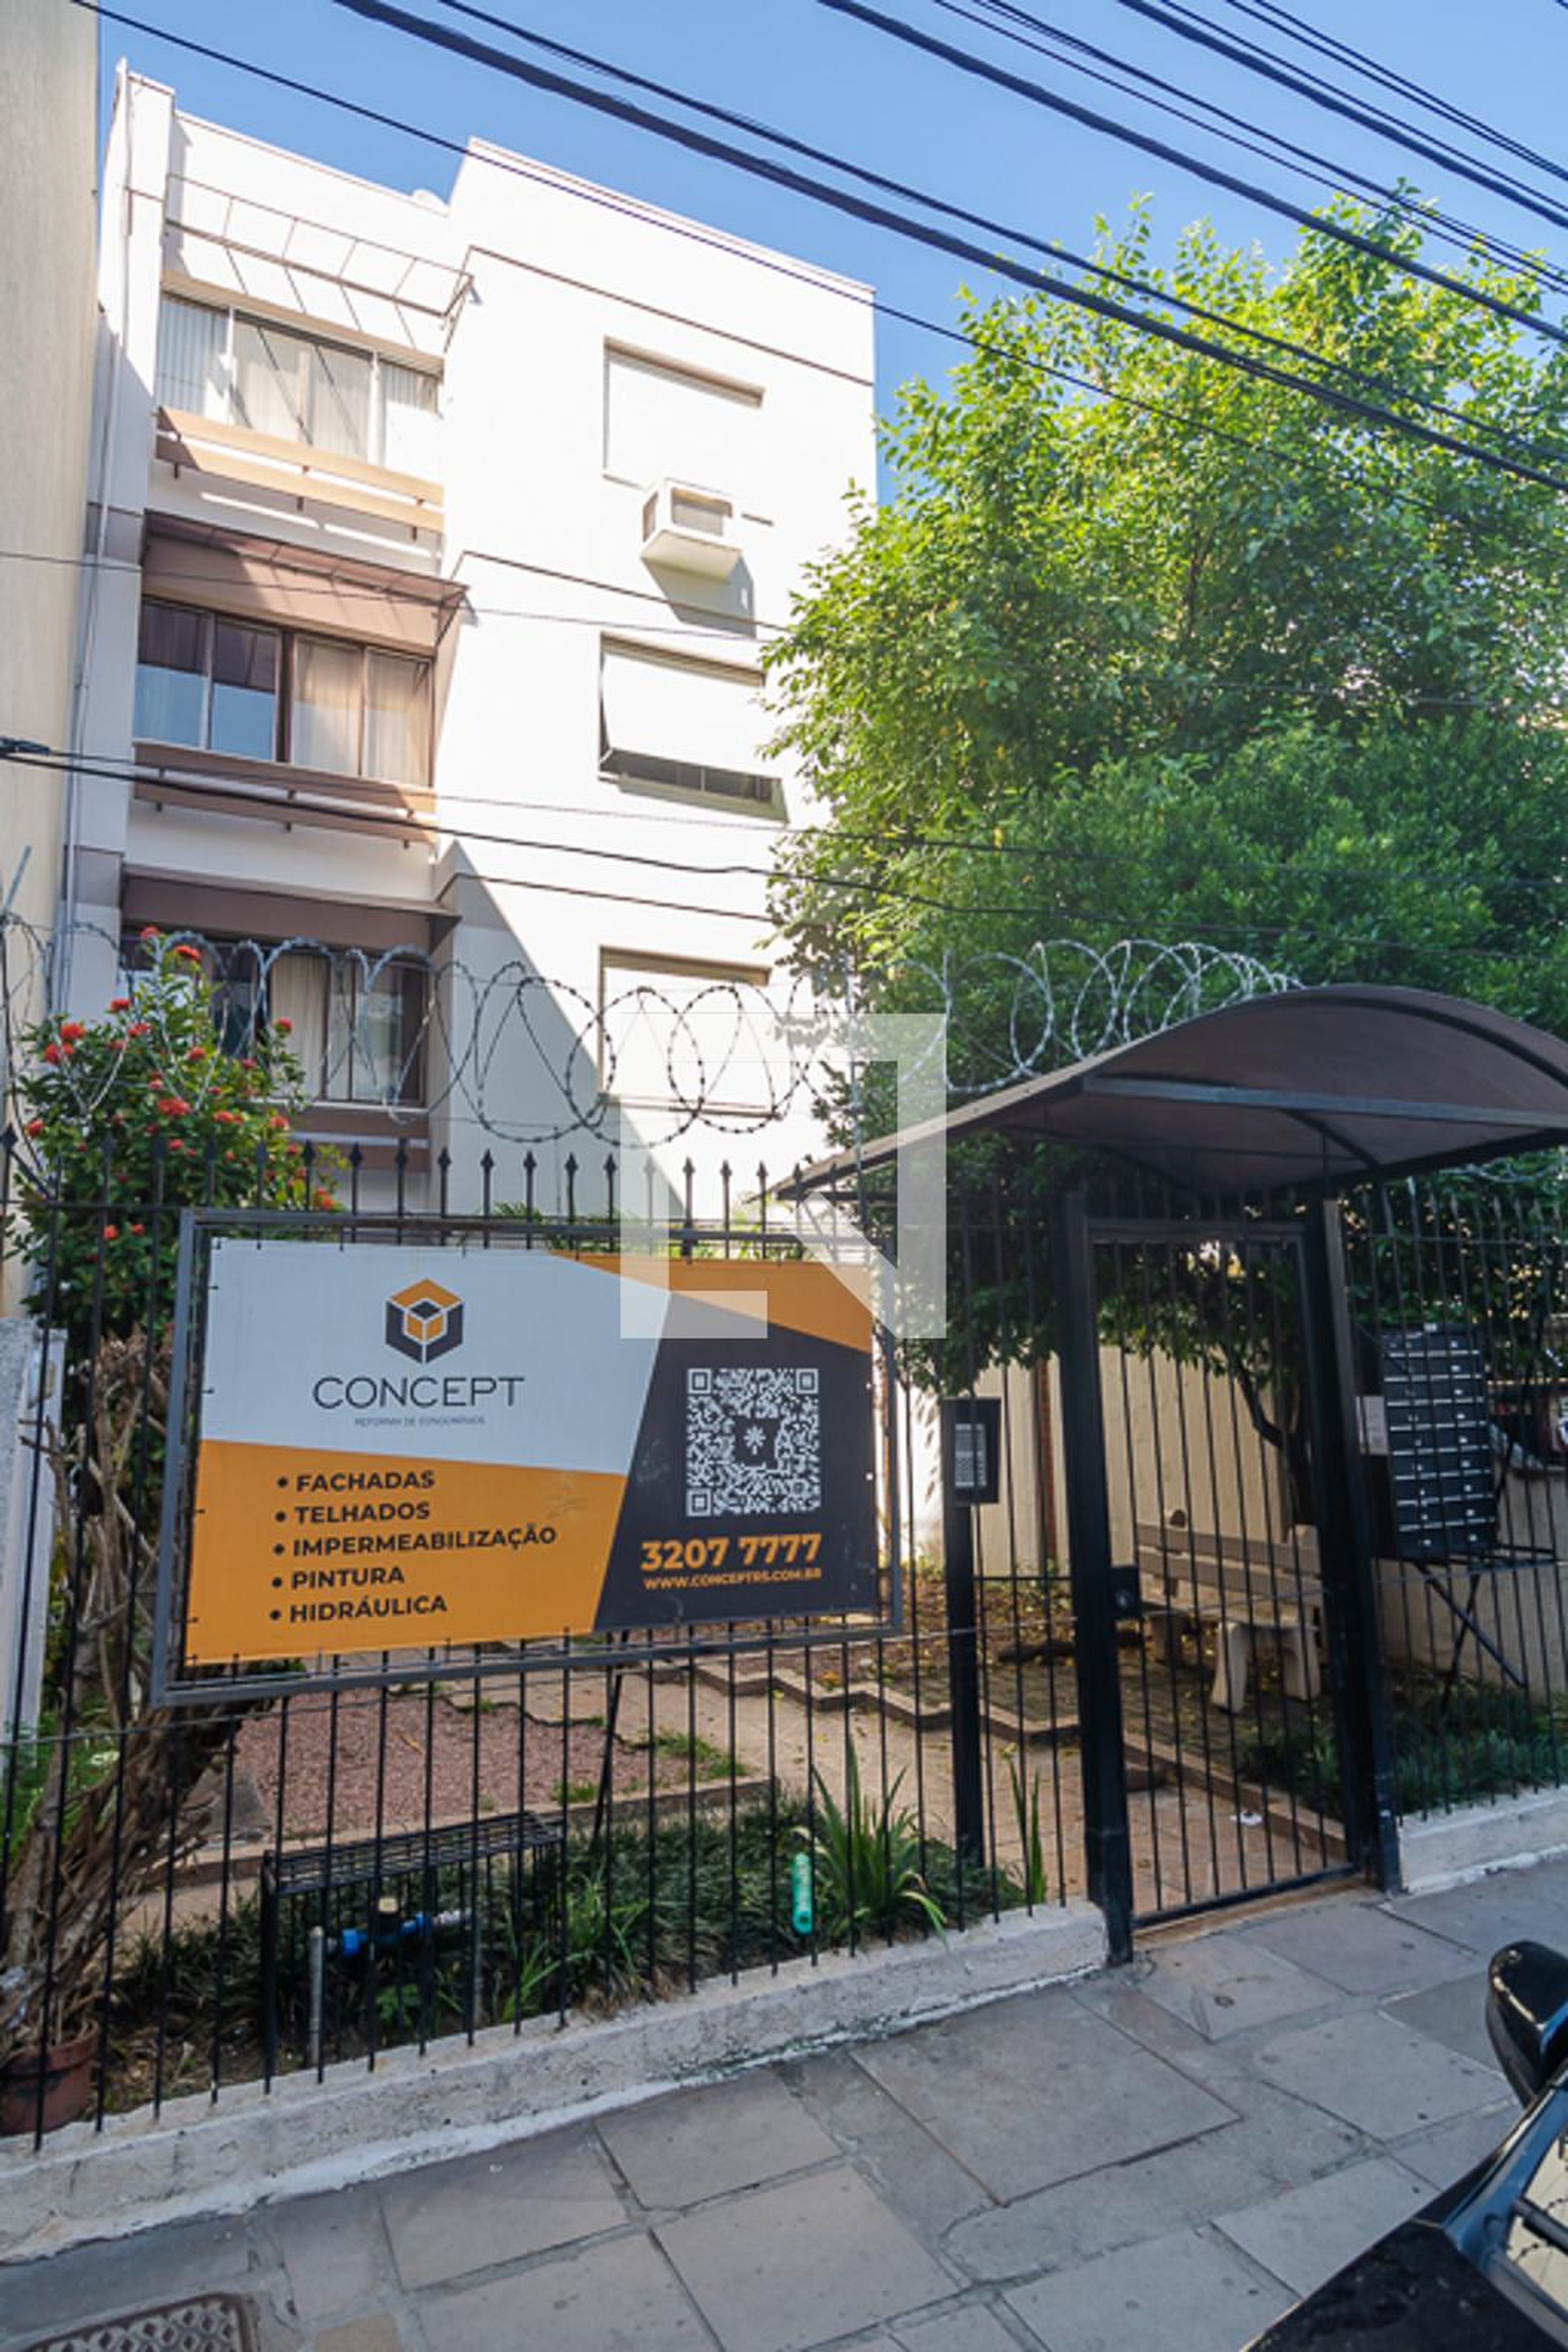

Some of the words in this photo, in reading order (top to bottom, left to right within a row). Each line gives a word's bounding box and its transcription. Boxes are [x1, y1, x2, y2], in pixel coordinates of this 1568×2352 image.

[313, 1376, 525, 1409] CONCEPT
[296, 1470, 434, 1492] FACHADAS
[294, 1501, 430, 1524] TELHADOS
[293, 1522, 557, 1556] IMPERMEABILIZAÇÃO
[640, 1537, 729, 1571] 3207
[739, 1532, 822, 1565] 7777
[291, 1566, 405, 1589] PINTURA
[290, 1595, 447, 1623] HIDRÁULICA
